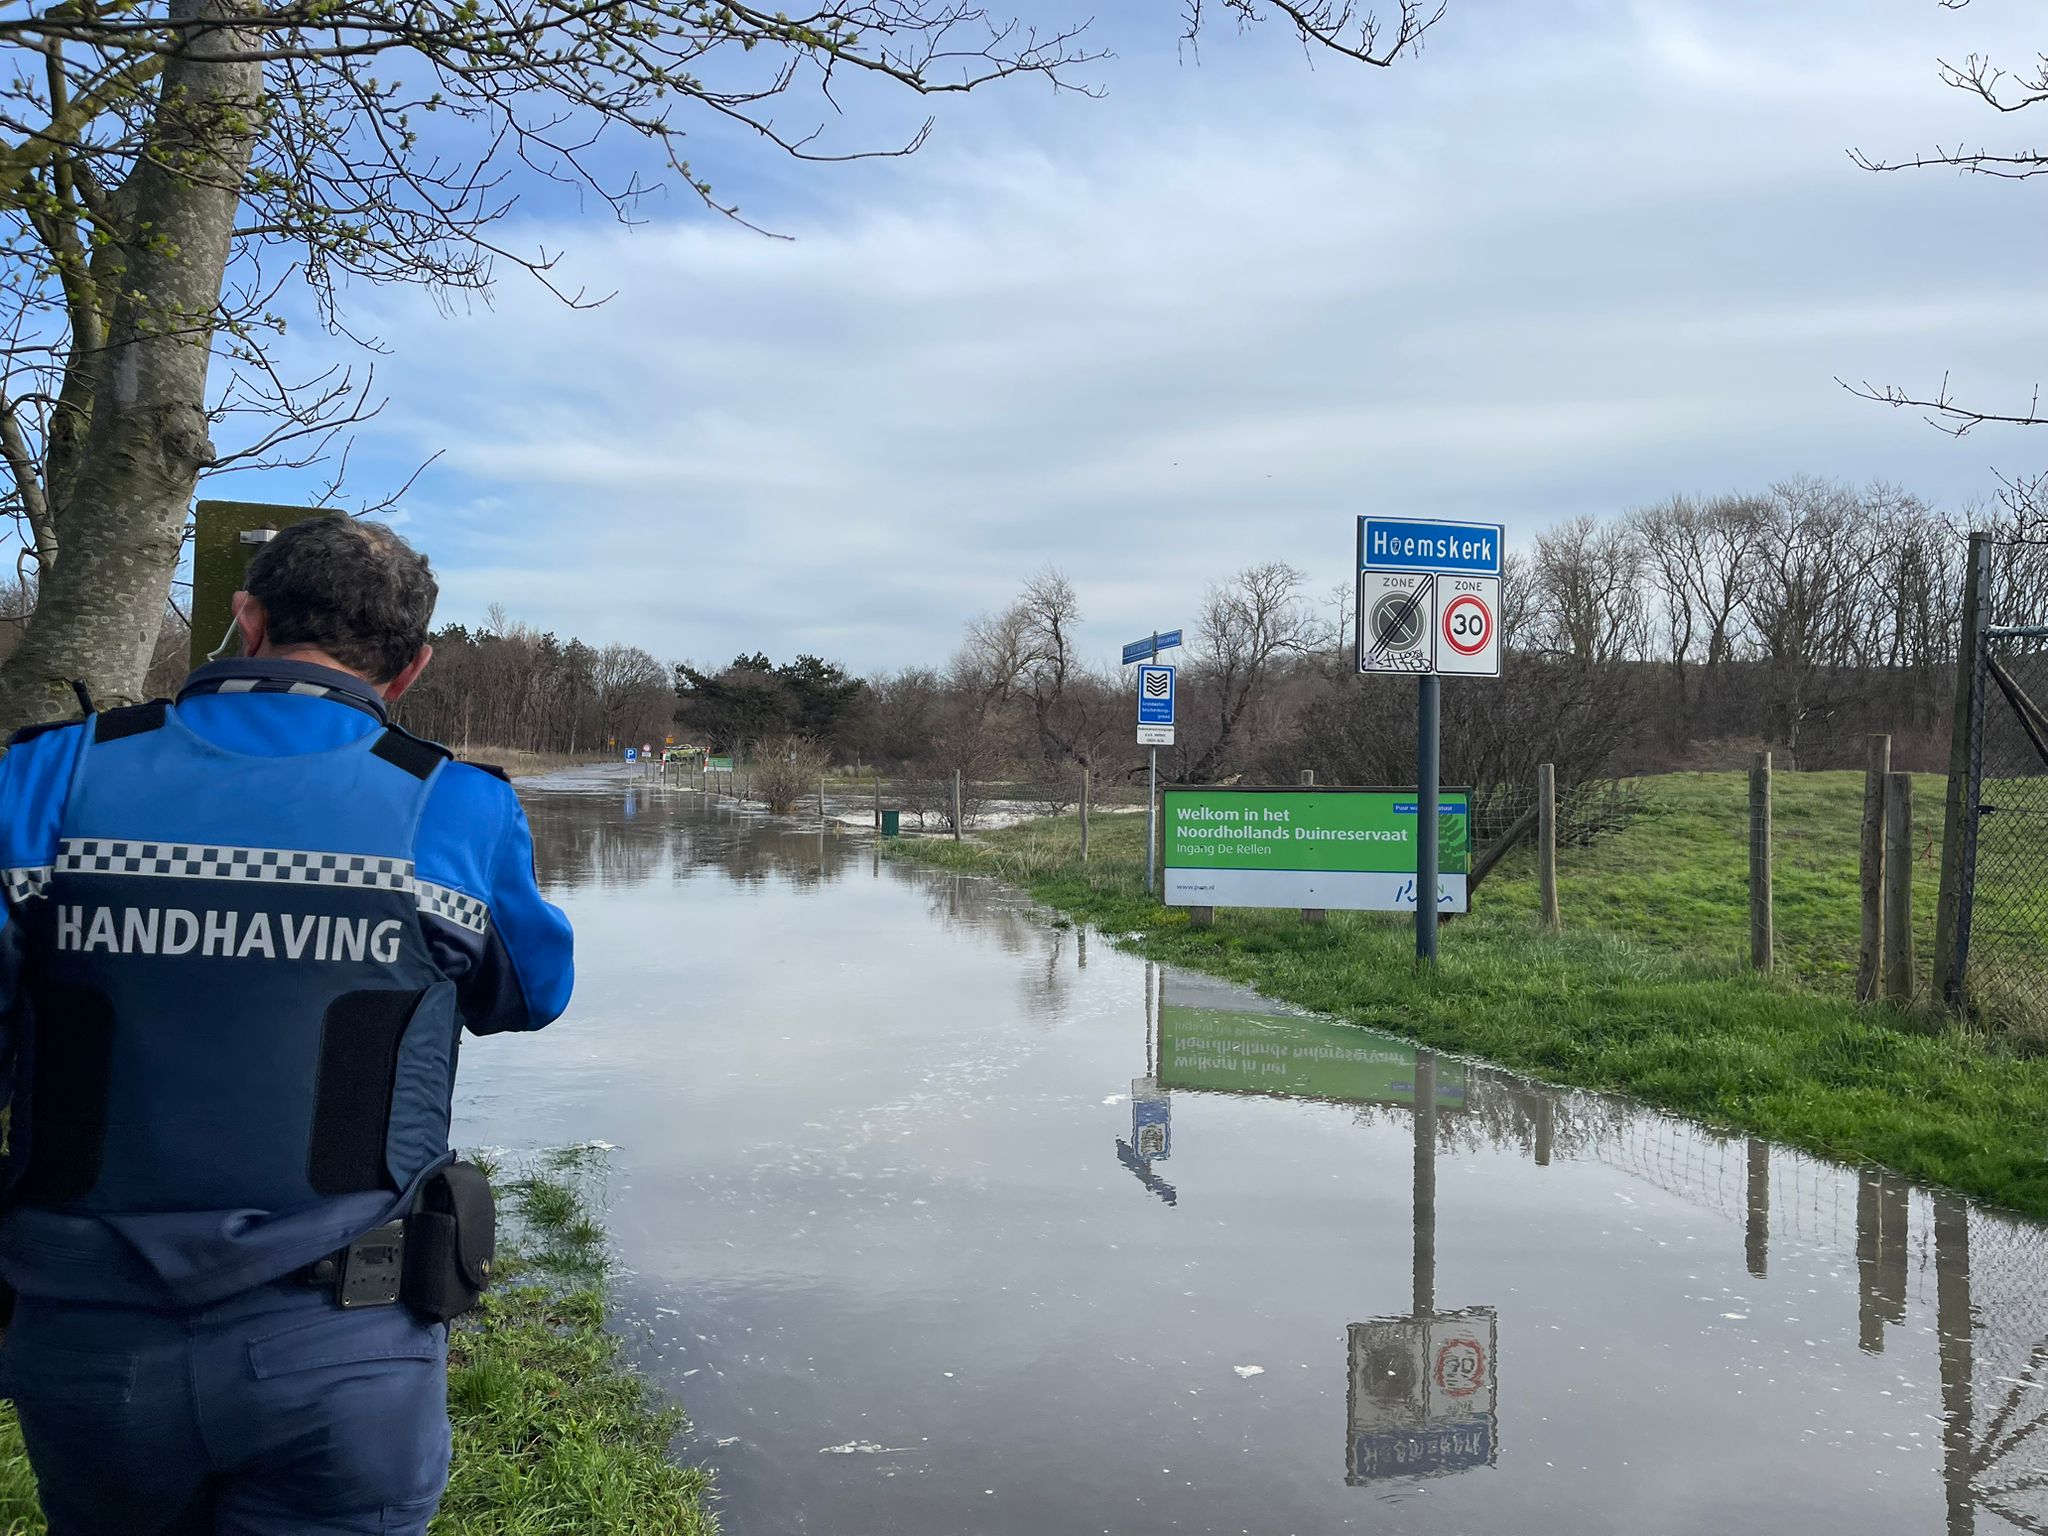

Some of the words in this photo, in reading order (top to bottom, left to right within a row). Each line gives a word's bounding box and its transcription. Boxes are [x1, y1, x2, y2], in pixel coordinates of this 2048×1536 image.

[1382, 577, 1415, 588] ZONE
[1455, 580, 1483, 592] ZONE
[1453, 613, 1483, 637] 30
[627, 749, 635, 758] P
[1176, 806, 1239, 821] Welkom
[1244, 807, 1259, 821] in
[1263, 807, 1290, 822] het
[1176, 825, 1290, 840] Noordhollands
[1294, 827, 1408, 841] Duinreservaat
[1176, 844, 1215, 856] Ingang
[1218, 844, 1233, 854] De
[1236, 844, 1272, 855] Rellen
[57, 903, 403, 964] HANDHAVING
